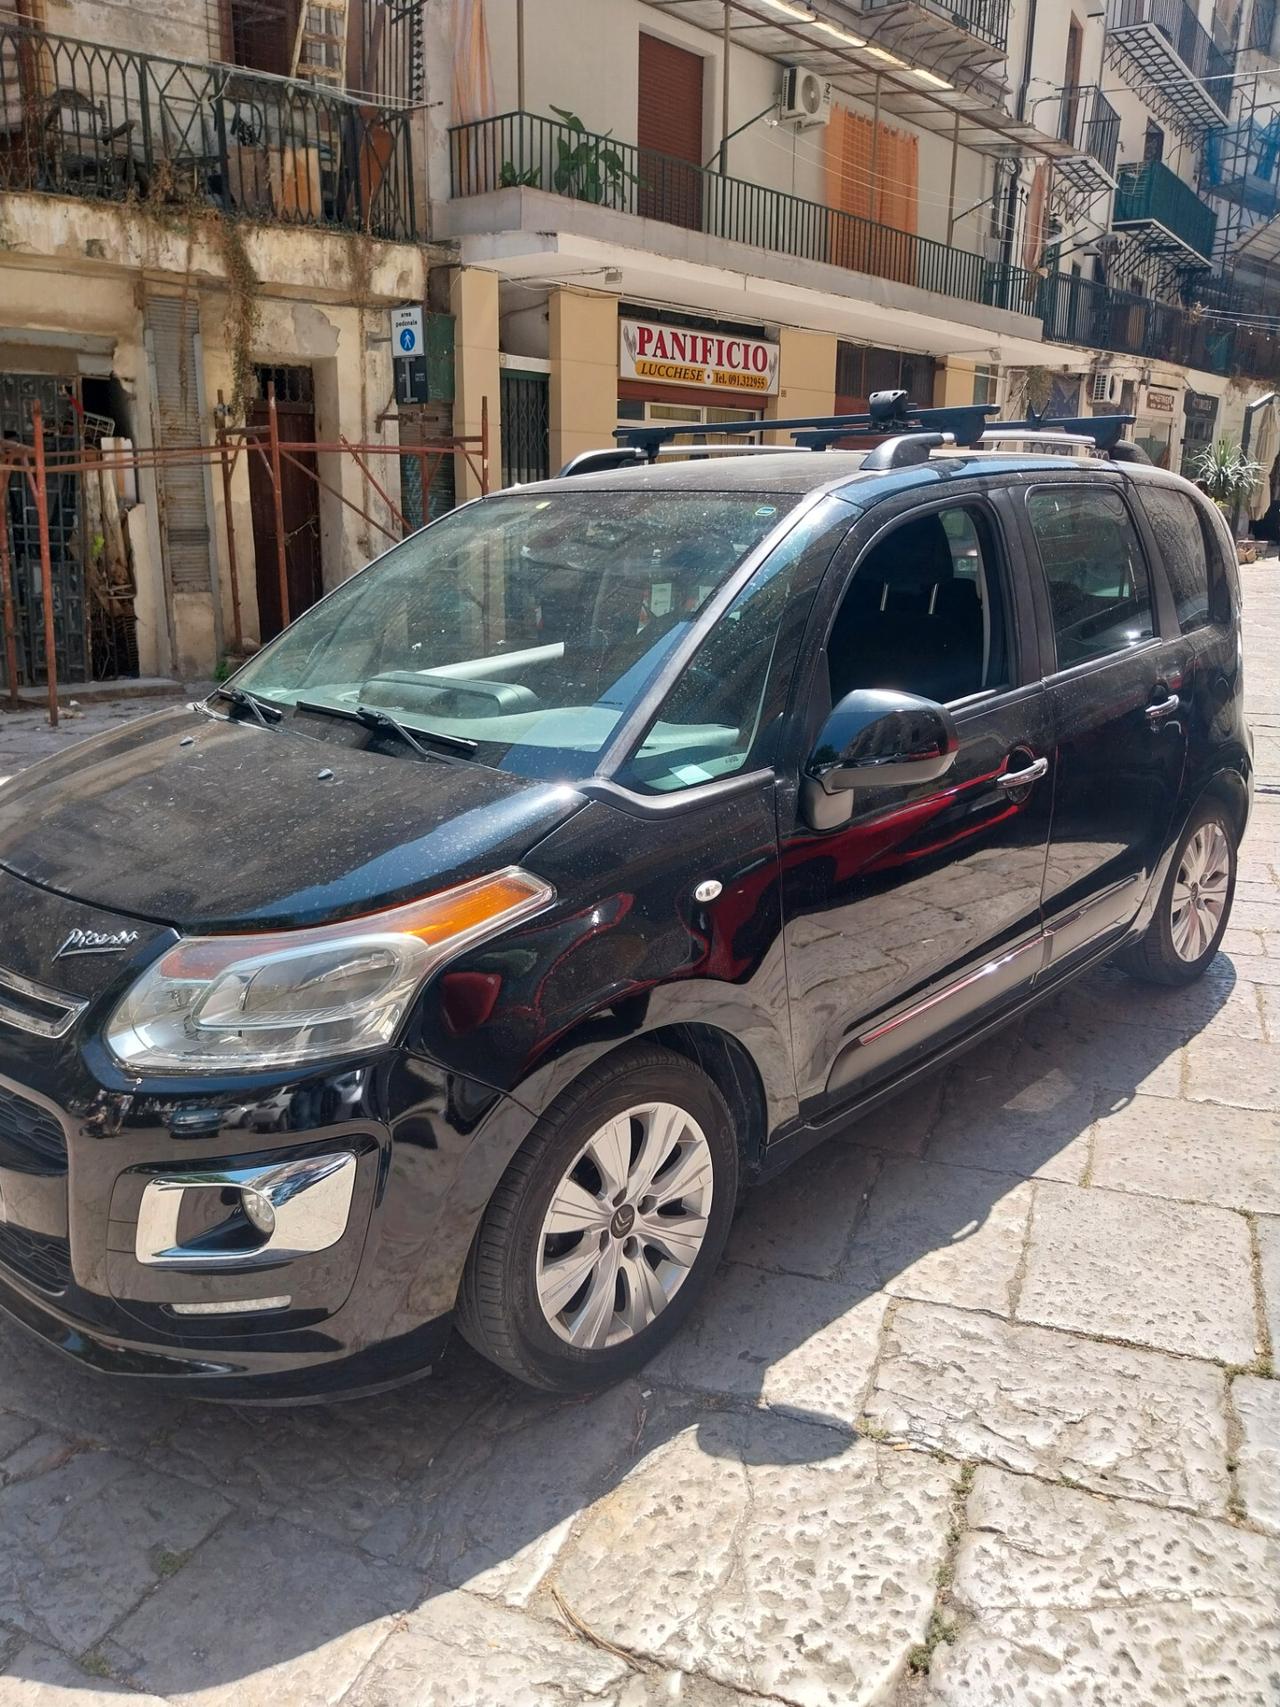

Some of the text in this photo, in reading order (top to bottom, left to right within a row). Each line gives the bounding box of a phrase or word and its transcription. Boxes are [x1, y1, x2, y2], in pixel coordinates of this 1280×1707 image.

[637, 326, 768, 372] PANIFICIO
[641, 363, 703, 381] LUCCHESE
[715, 373, 727, 384] Tel.
[52, 928, 139, 962] Picasso
